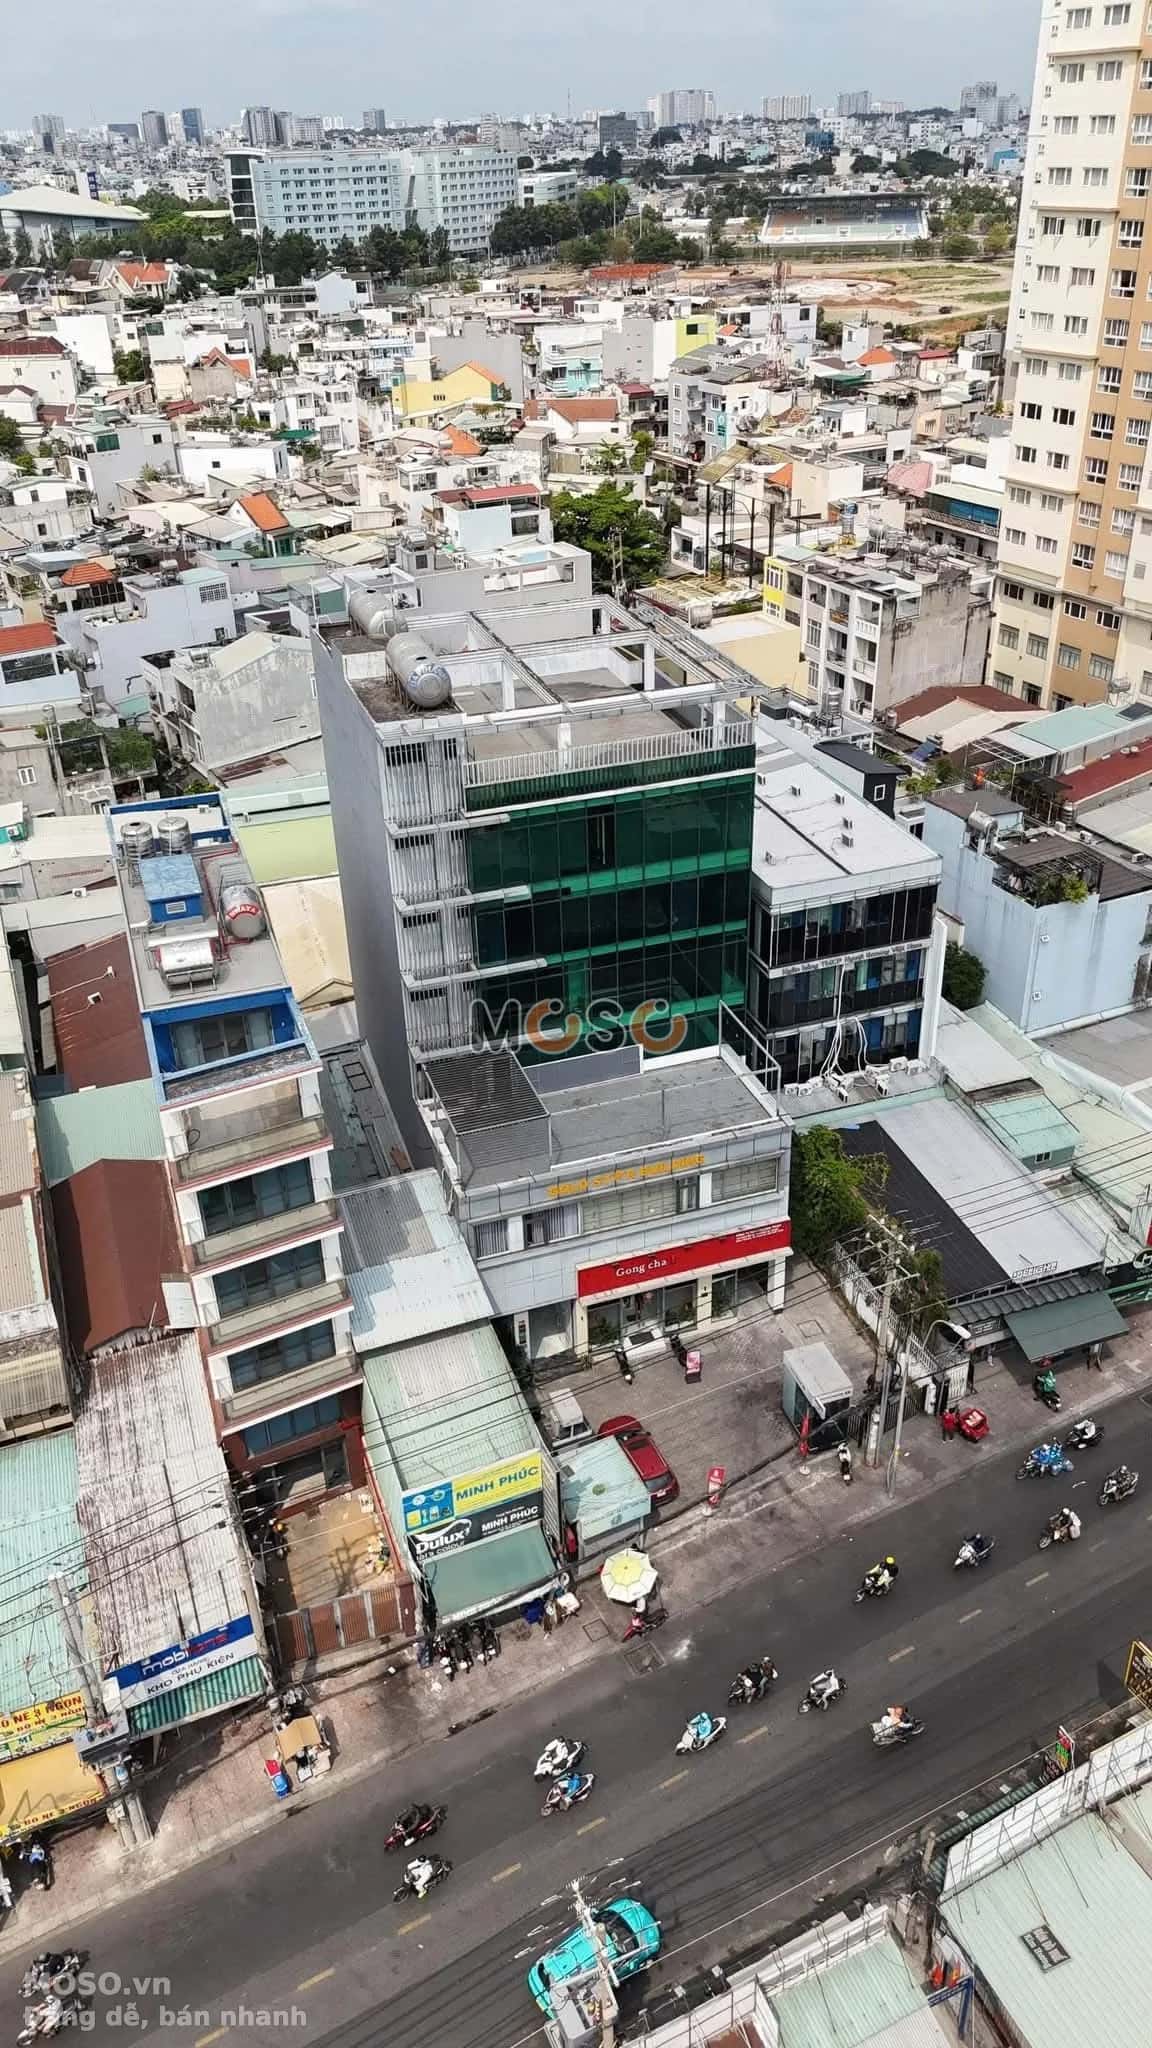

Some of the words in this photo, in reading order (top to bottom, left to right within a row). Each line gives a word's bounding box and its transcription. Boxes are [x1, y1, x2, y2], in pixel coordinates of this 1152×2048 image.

[616, 1264, 646, 1277] Gong
[648, 1259, 667, 1269] cha
[456, 1481, 494, 1501] MINH
[499, 1466, 539, 1487] PHÚC
[482, 1518, 508, 1532] MINH
[510, 1505, 539, 1520] PHÚC
[416, 1532, 466, 1555] Dulux
[147, 1680, 173, 1694] KHO
